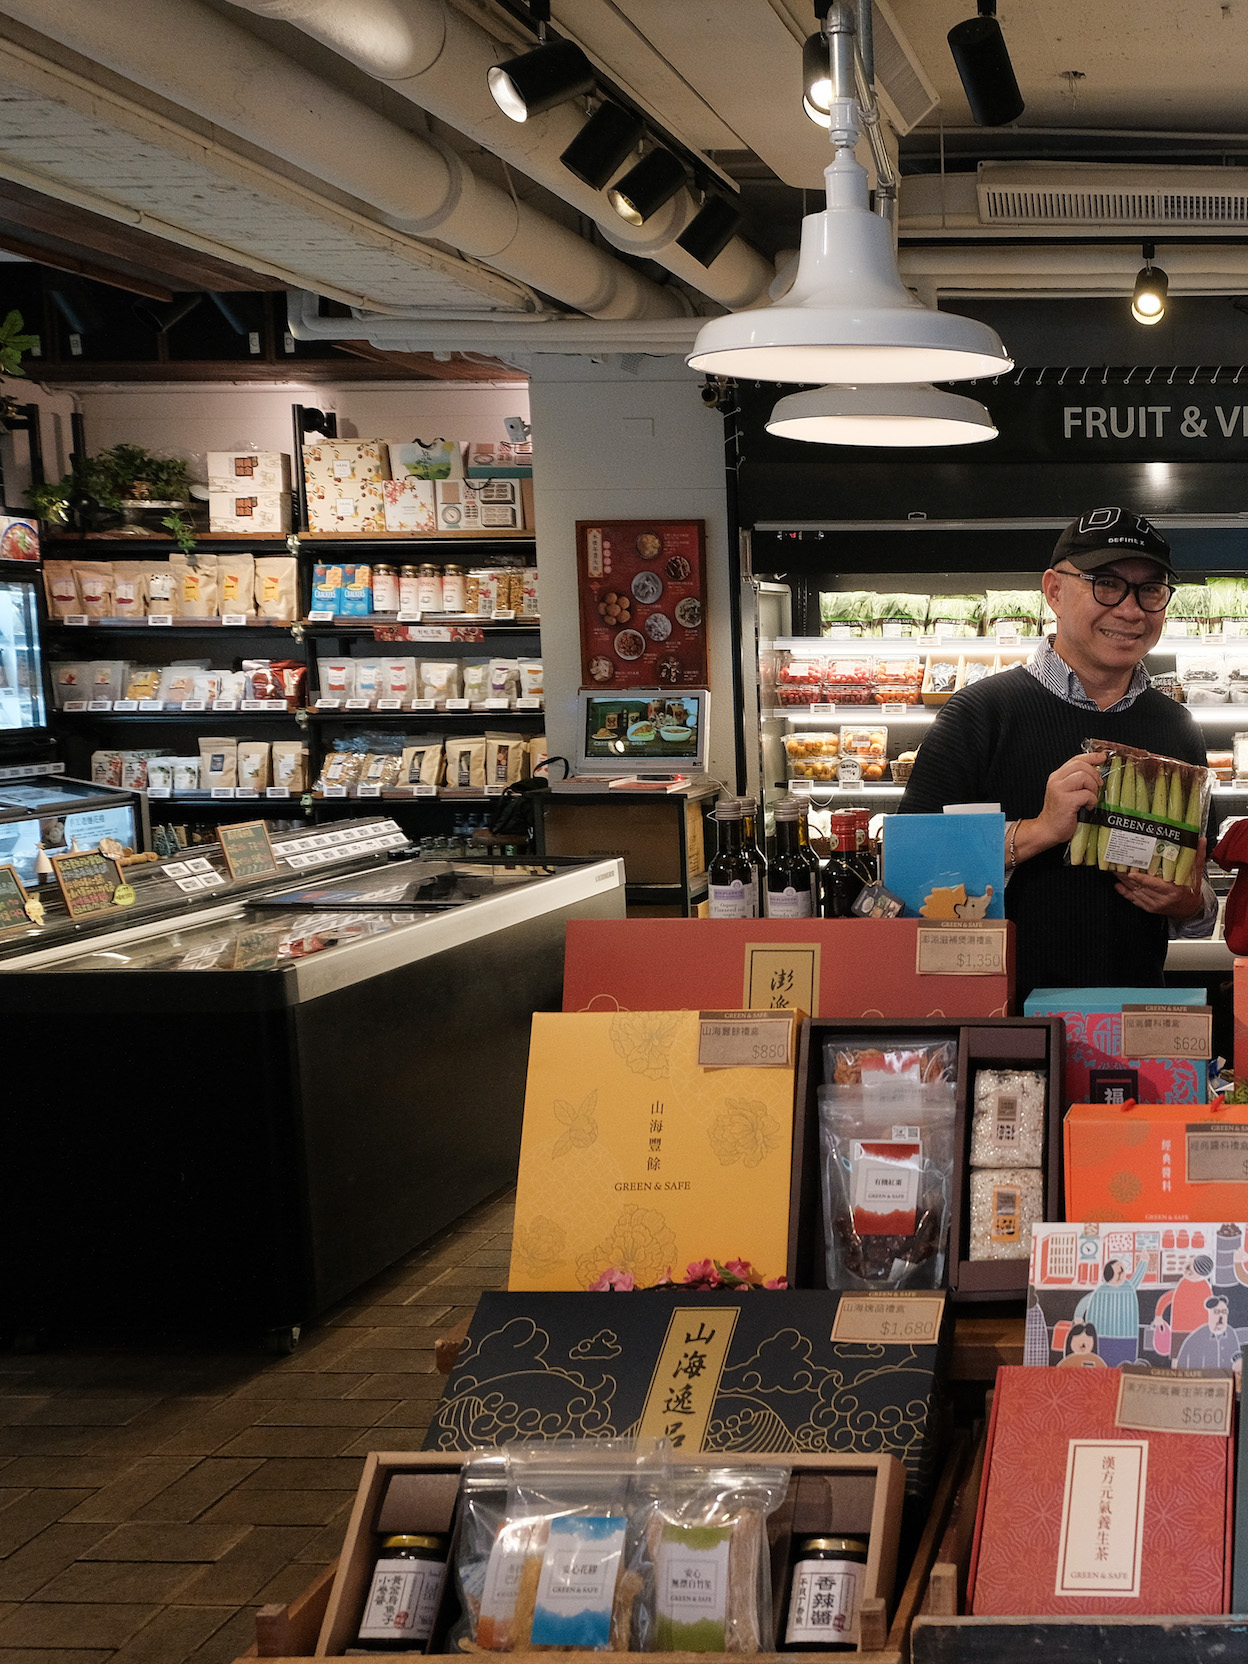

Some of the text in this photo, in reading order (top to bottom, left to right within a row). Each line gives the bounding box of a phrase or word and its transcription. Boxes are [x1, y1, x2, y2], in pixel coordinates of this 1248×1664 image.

[1064, 406, 1171, 438] FRUIT
[1180, 406, 1208, 438] &
[1107, 815, 1181, 841] GREEN & SAFE
[957, 954, 1000, 967] $1,350
[752, 1045, 785, 1059] $880
[1174, 1037, 1206, 1051] $620
[647, 1100, 664, 1171] 山海豐餘
[614, 1181, 691, 1191] GREEN & SAFE
[880, 1320, 933, 1336] $1,680
[662, 1322, 716, 1448] 山海逸品
[1182, 1407, 1224, 1424] $560
[1095, 1455, 1116, 1562] 漢方元氣養生茶
[1070, 1571, 1100, 1580] GREEN
[1109, 1571, 1128, 1580] SAFE
[552, 1586, 575, 1594] GREEN
[670, 1594, 690, 1602] GREEN
[811, 1575, 837, 1626] 香辣醬
